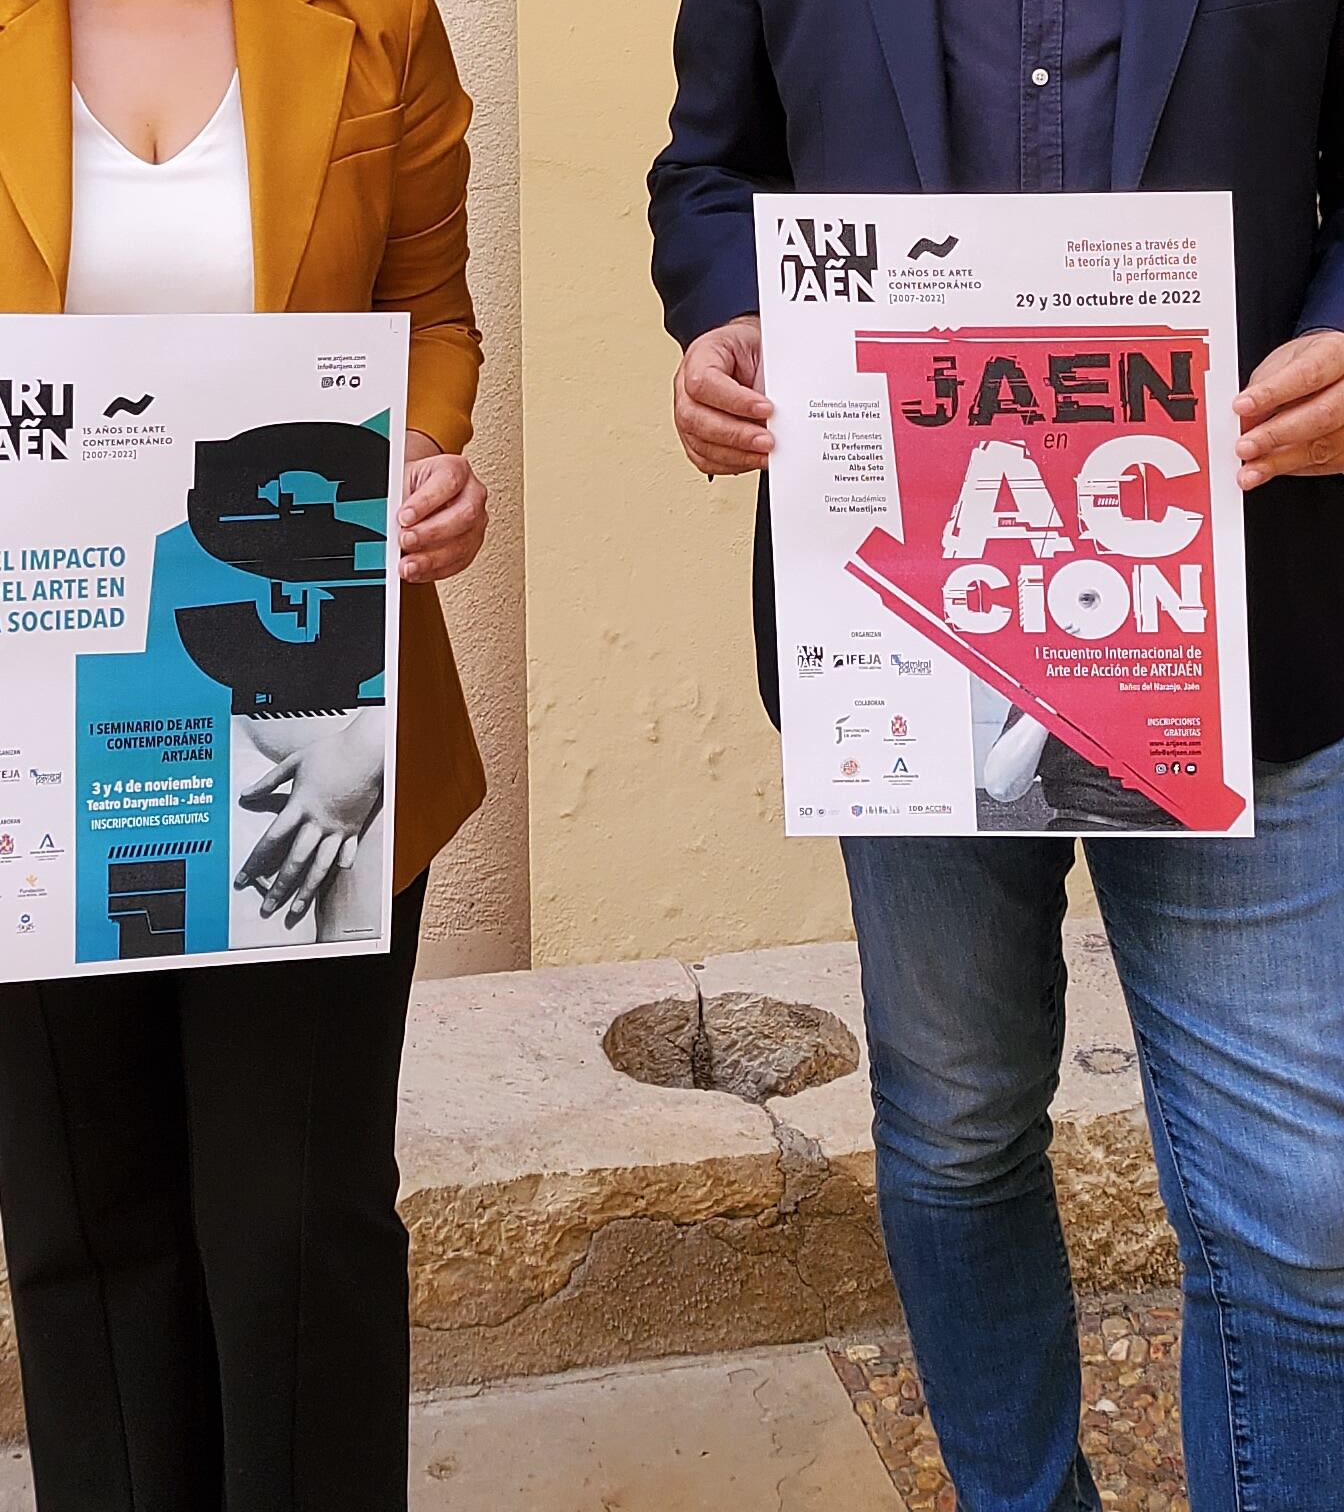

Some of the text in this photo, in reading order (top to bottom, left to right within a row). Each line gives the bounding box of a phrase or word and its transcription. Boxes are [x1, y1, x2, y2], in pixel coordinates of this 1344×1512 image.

[777, 218, 878, 267] ART
[1067, 238, 1196, 252] Reflexiones a través de
[1065, 253, 1197, 269] la teoría y la práctica de
[900, 268, 929, 277] AÑOS
[1112, 269, 1198, 284] la performance
[889, 280, 982, 289] CONTEMPORÁNEO
[889, 294, 945, 304] [2007-2022]
[1016, 290, 1201, 311] 29 y 30 octubre de 2022
[901, 351, 1198, 427] JAEN
[809, 400, 880, 410] Conferencia Inaugural
[826, 411, 841, 419] Luis
[843, 411, 859, 419] Anta
[82, 427, 92, 435] 15
[96, 425, 123, 434] AÑOS
[82, 437, 173, 447] CONTEMPORÁNEO
[1044, 432, 1068, 449] en
[82, 450, 137, 461] [2007-2022]
[822, 452, 846, 461] Álvaro
[825, 495, 886, 503] Director Académico
[941, 435, 1204, 559] AC
[848, 505, 887, 514] Montijano
[21, 546, 126, 570] IMPACTO
[32, 578, 88, 601] ARTE
[97, 577, 125, 598] EN
[8, 607, 125, 632] SOCIEDAD
[846, 654, 881, 664] IFEJA
[1035, 645, 1202, 659] I Encuentro Internacional de
[1046, 661, 1202, 676] Arte de Acción de ARTJAÉN
[1142, 682, 1152, 691] del
[1184, 682, 1200, 691] Jaén
[90, 717, 213, 735] I SEMINARIO DE ARTE
[1147, 717, 1201, 726] INSCRIPCIONES
[107, 732, 212, 749] CONTEMPORÁNEO
[162, 747, 212, 762] ARTJAÉN
[92, 776, 213, 797] 3 y 4 de noviembre
[87, 800, 120, 811] Teatro
[123, 795, 179, 810] Darymella
[187, 793, 212, 805] Jaén
[91, 813, 209, 830] INSCRIPCIONES GRATUITAS
